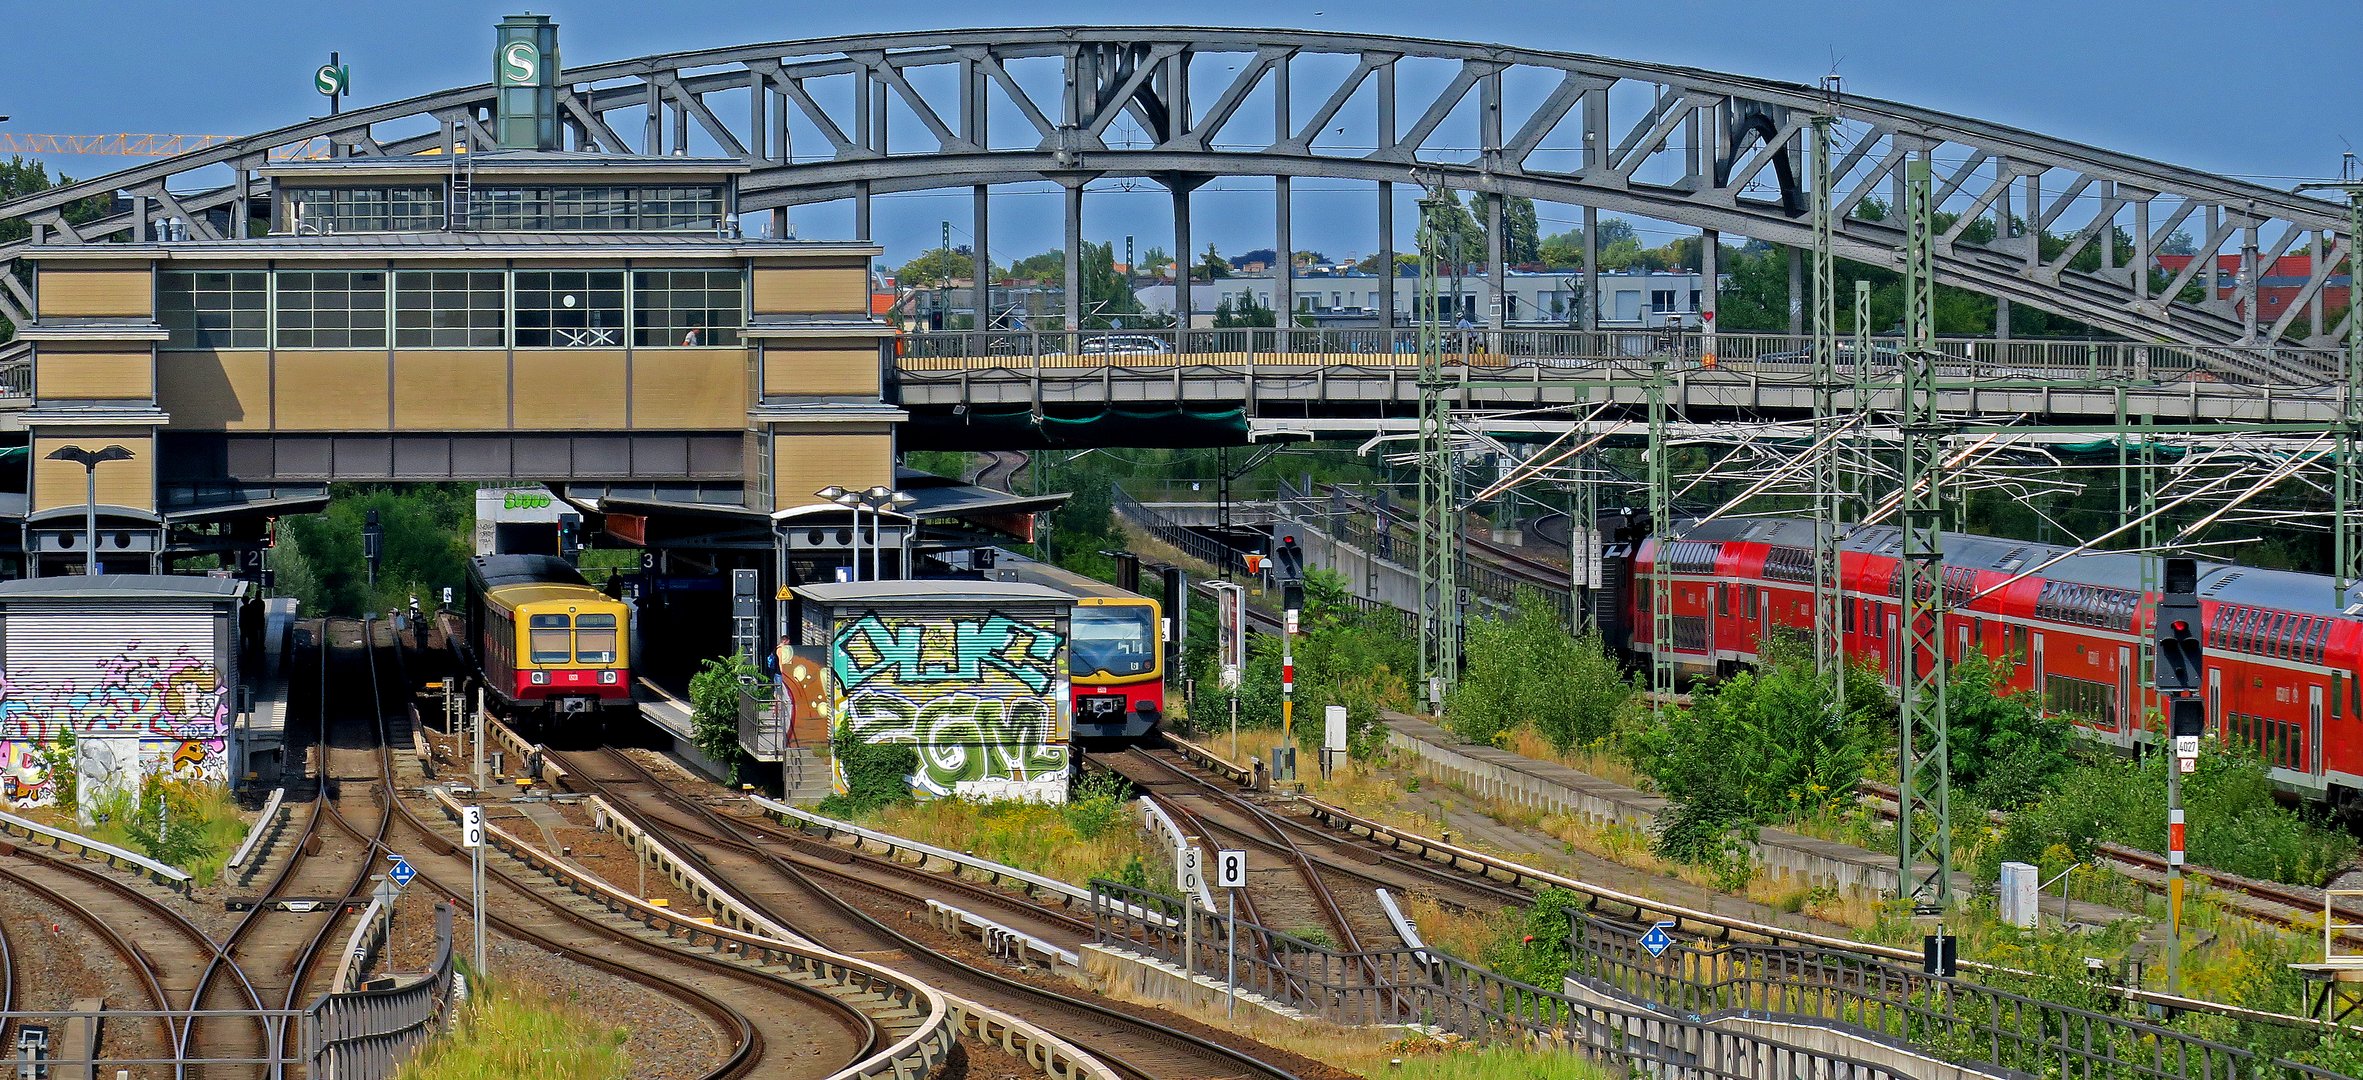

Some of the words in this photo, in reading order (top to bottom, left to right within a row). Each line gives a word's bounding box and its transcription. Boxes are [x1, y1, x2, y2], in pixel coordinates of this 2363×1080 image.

[505, 44, 535, 82] S
[318, 66, 338, 94] S
[248, 550, 258, 566] 2
[643, 553, 654, 568] 3
[981, 549, 993, 565] 4
[1459, 588, 1467, 603] 8
[2178, 741, 2196, 753] 4027
[1225, 855, 1238, 882] 8
